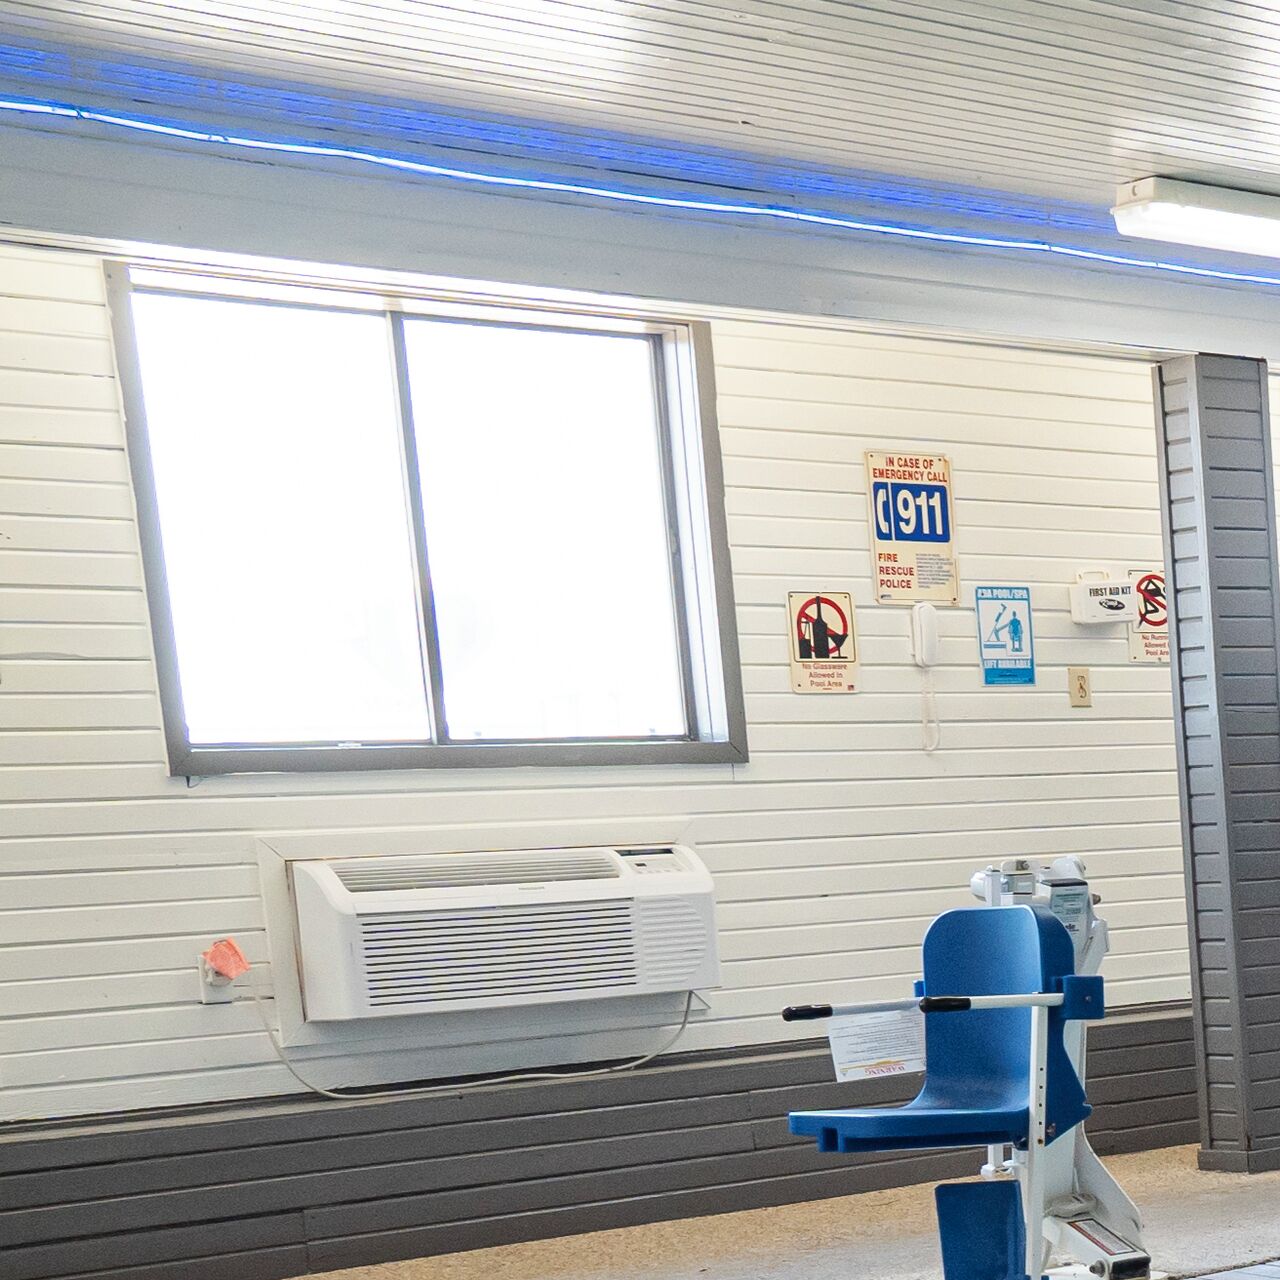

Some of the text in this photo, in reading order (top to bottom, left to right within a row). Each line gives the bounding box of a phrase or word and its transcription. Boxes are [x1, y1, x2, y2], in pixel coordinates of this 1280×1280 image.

[886, 457, 934, 469] IN CASE OF
[872, 468, 948, 483] EMERGENCY CALL
[896, 489, 943, 535] 911
[878, 553, 898, 562] FIRE
[879, 566, 914, 576] RESCUE
[880, 579, 912, 589] POLICE
[1089, 586, 1131, 597] FIRST AID KIT
